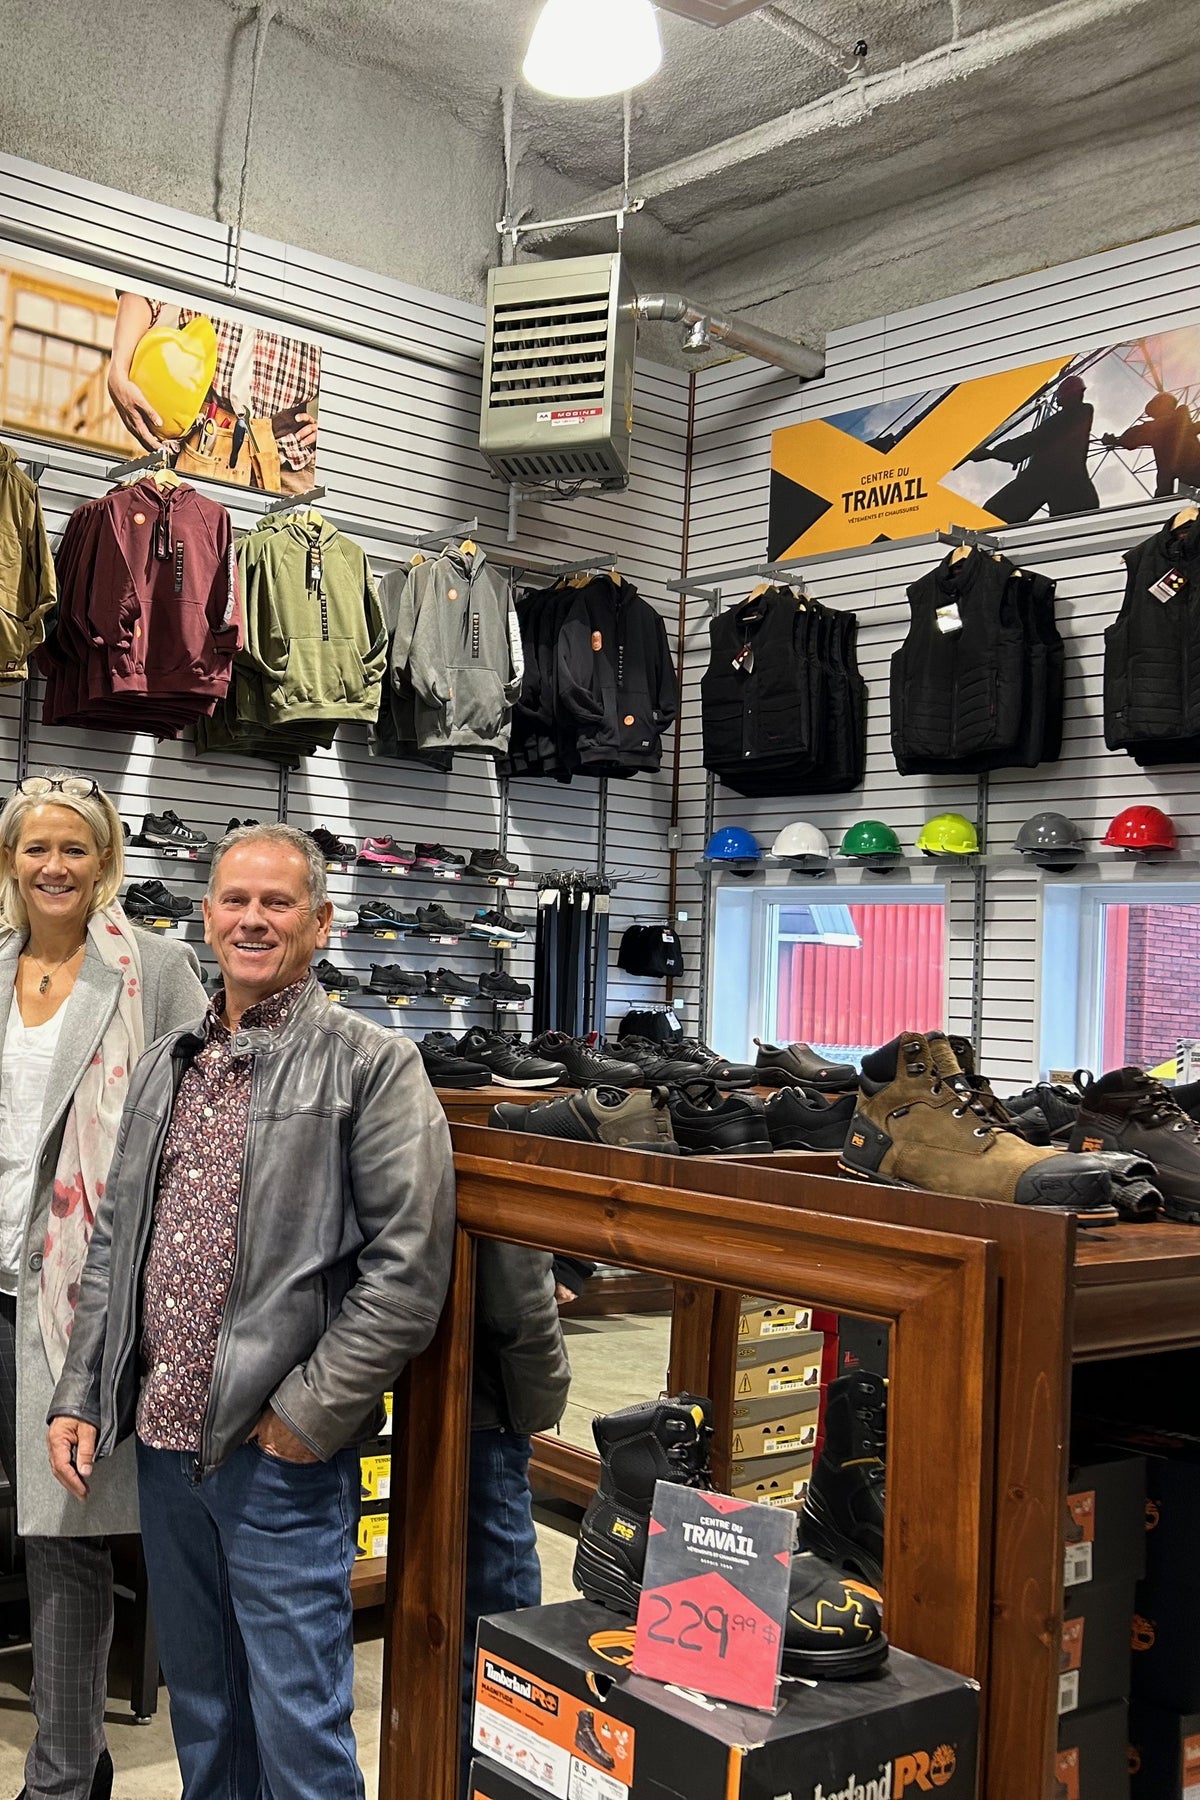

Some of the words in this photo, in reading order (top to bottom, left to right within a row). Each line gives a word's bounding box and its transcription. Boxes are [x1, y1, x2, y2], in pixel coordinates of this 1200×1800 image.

[557, 409, 597, 418] MODINE
[860, 468, 894, 486] CENTRE
[897, 467, 910, 477] DU
[841, 477, 928, 513] TRAVAIL
[848, 514, 877, 524] VÊTEMENTS
[885, 505, 920, 517] CHAUSSURES
[700, 1516, 730, 1530] CENTRE
[731, 1522, 743, 1534] DU
[682, 1522, 758, 1558] TRAVAIL
[485, 1661, 532, 1699] Timberland
[531, 1685, 557, 1711] PRO
[574, 1760, 587, 1777] 8.5
